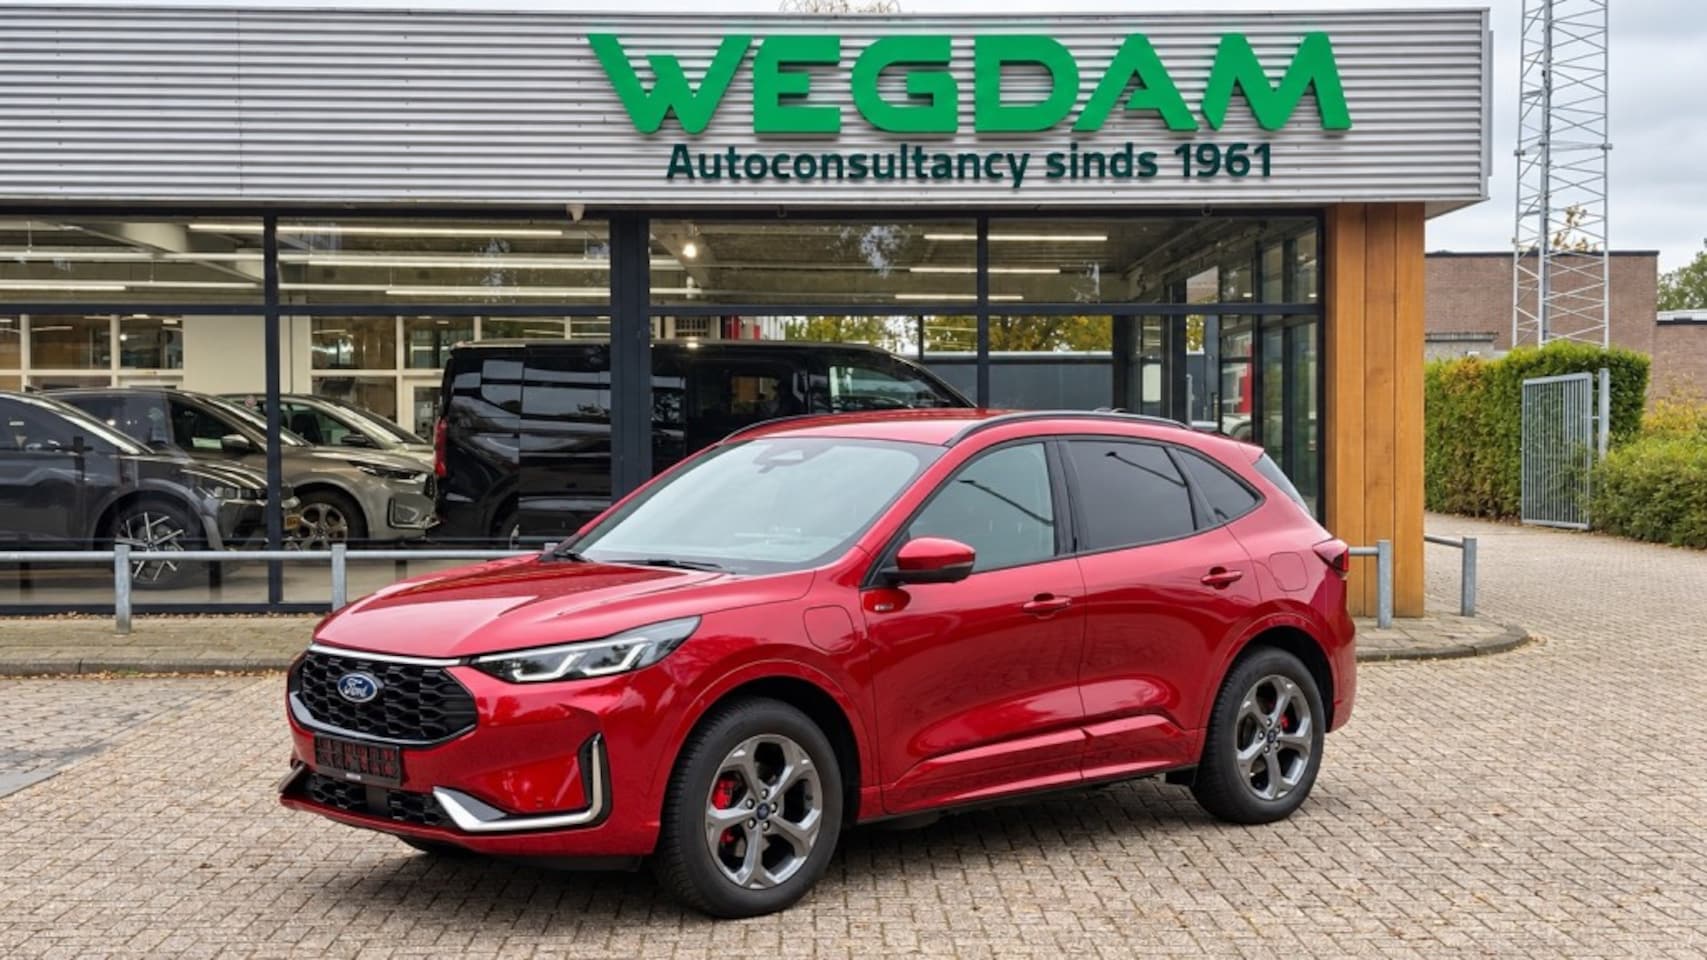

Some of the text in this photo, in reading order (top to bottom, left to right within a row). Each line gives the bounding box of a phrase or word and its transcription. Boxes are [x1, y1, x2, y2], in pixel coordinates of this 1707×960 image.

[587, 32, 1352, 135] WEGDAM
[666, 142, 1272, 188] Autoconsultancy sinds 1961
